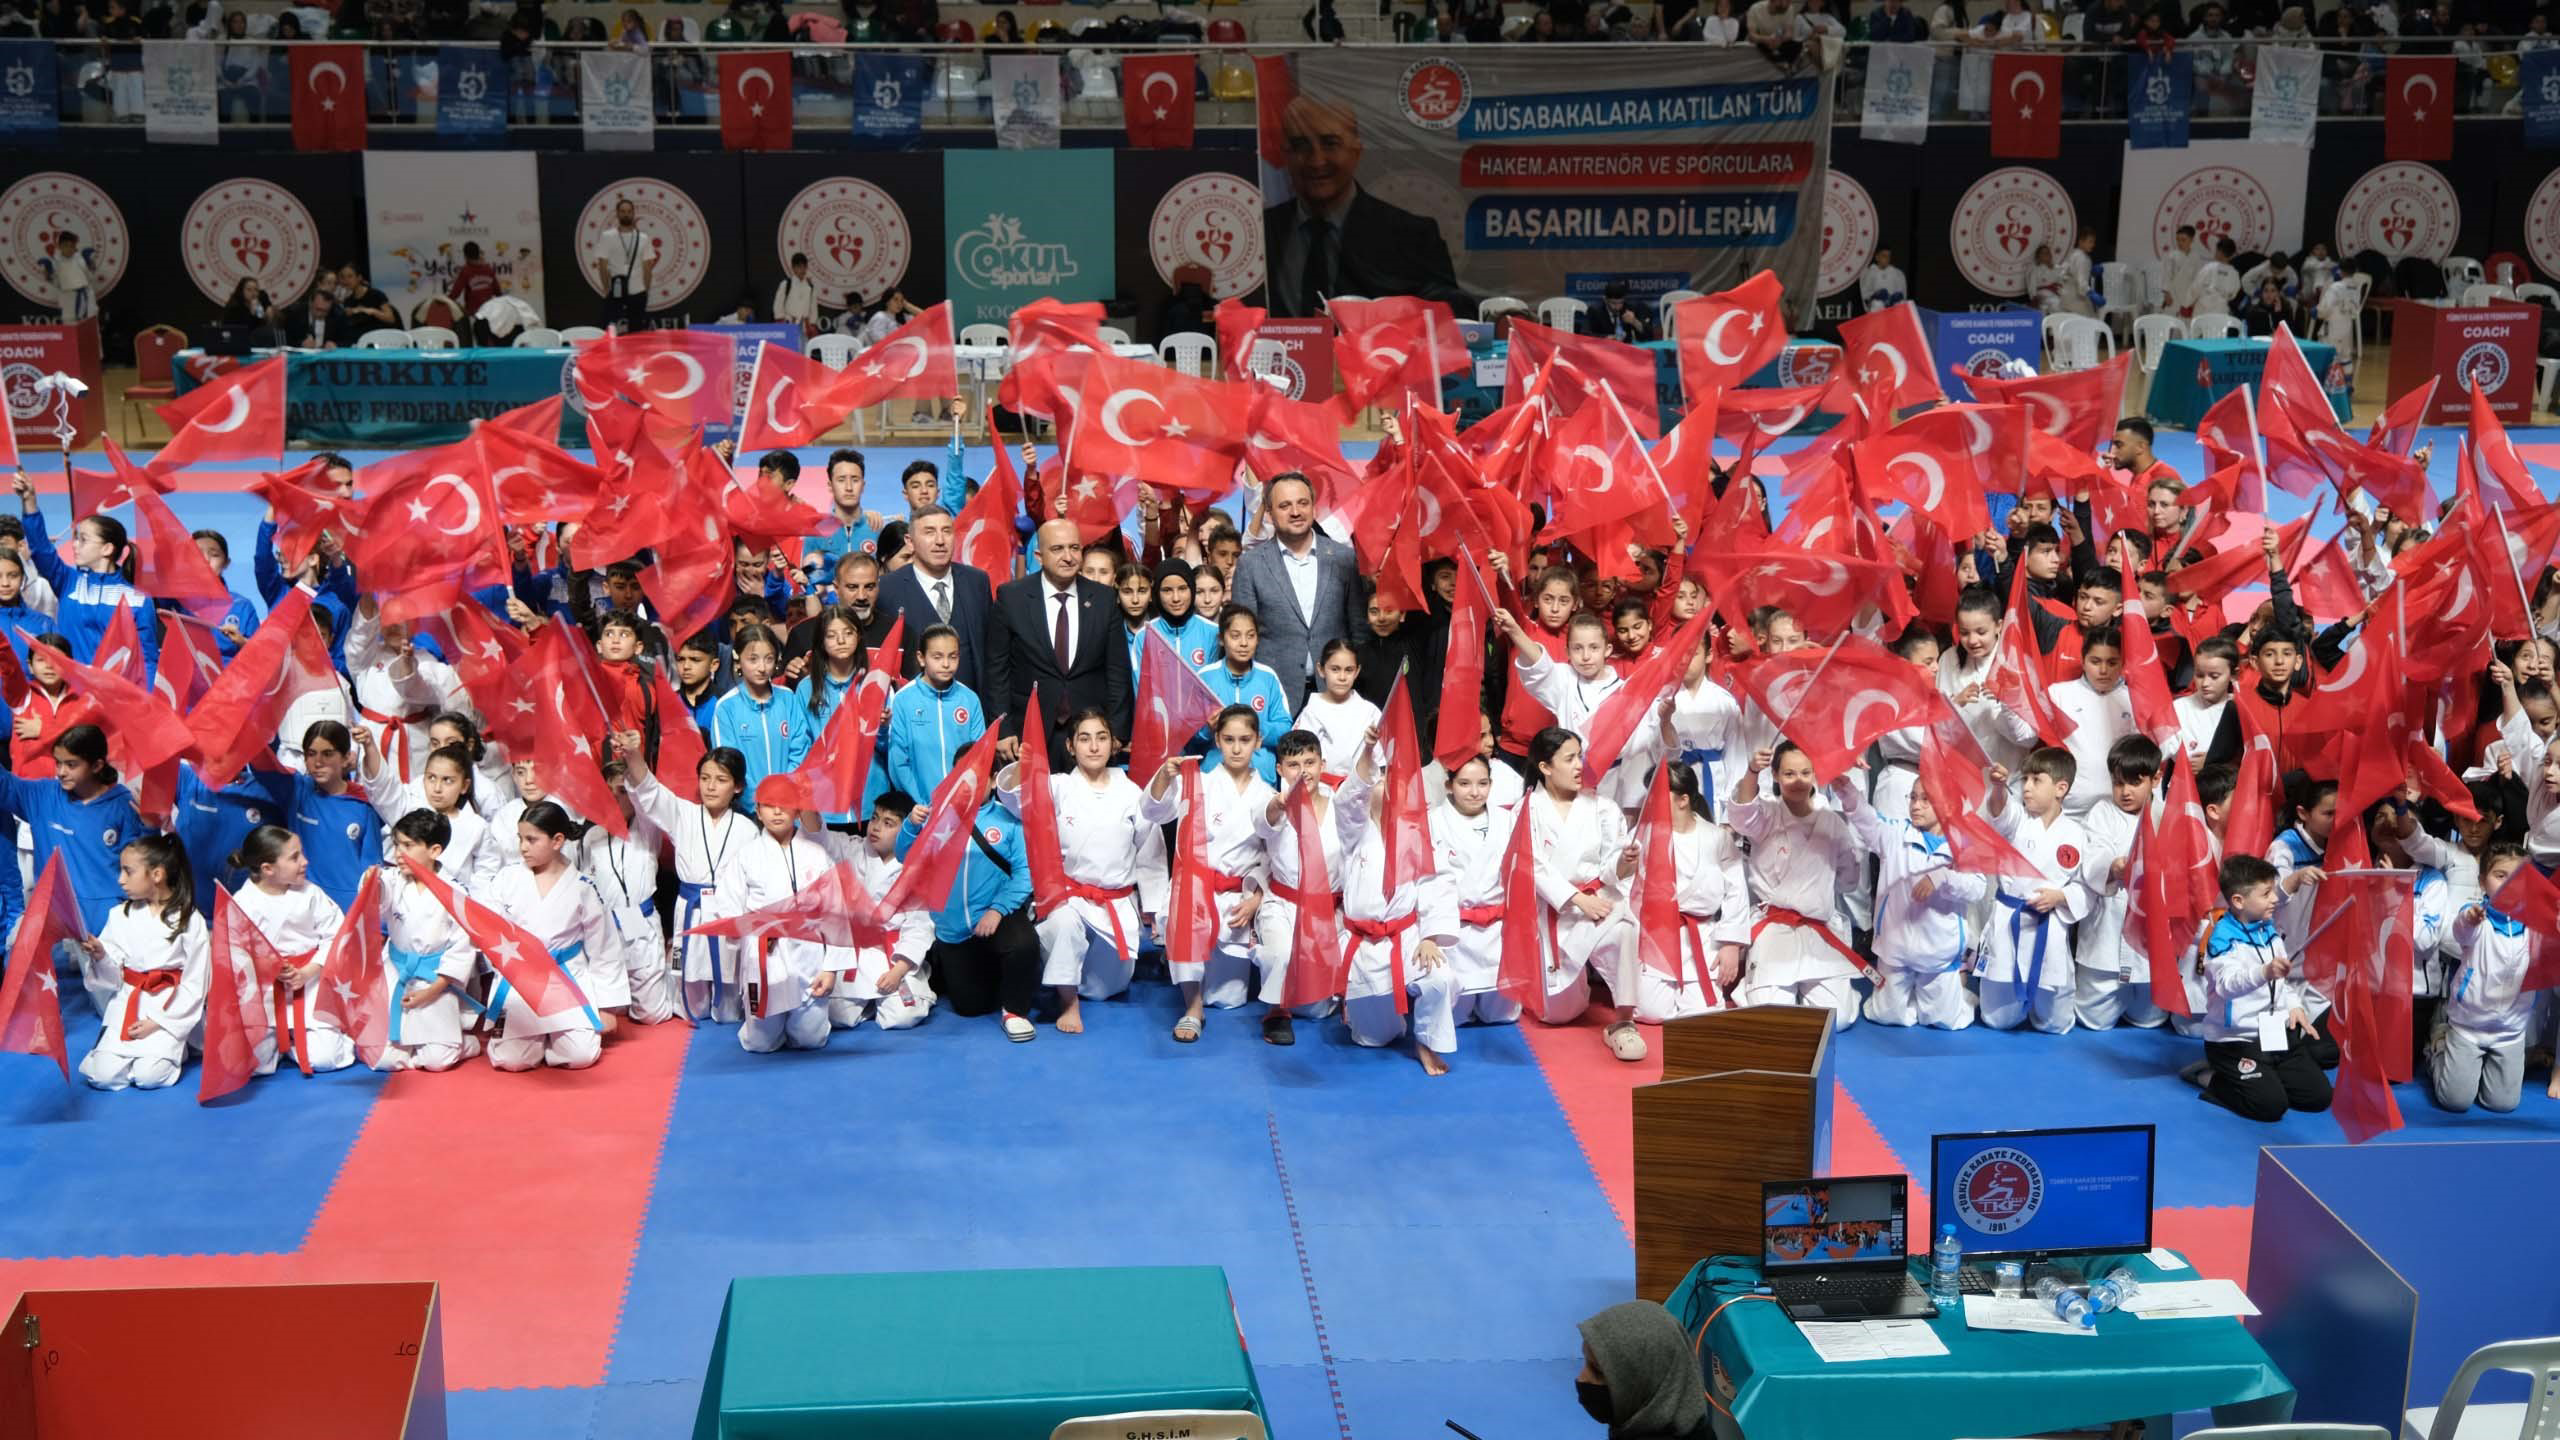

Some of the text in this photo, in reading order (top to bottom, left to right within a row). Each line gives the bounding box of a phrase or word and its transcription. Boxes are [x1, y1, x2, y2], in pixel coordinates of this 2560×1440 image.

[1474, 85, 1803, 132] MÜSABAKALARA KATILAN TÜM
[1648, 155, 1671, 175] VE
[1675, 153, 1794, 176] SPORCULARA
[1485, 197, 1777, 245] BAŞARILAR DİLERİM
[971, 242, 1078, 278] OKUL
[1967, 332, 2015, 345] COACH
[2463, 325, 2511, 339] COACH
[0, 346, 45, 359] OACH
[286, 400, 363, 425] ARATE
[1968, 1150, 2008, 1171] KARATE
[1988, 1222, 2007, 1232] 1981
